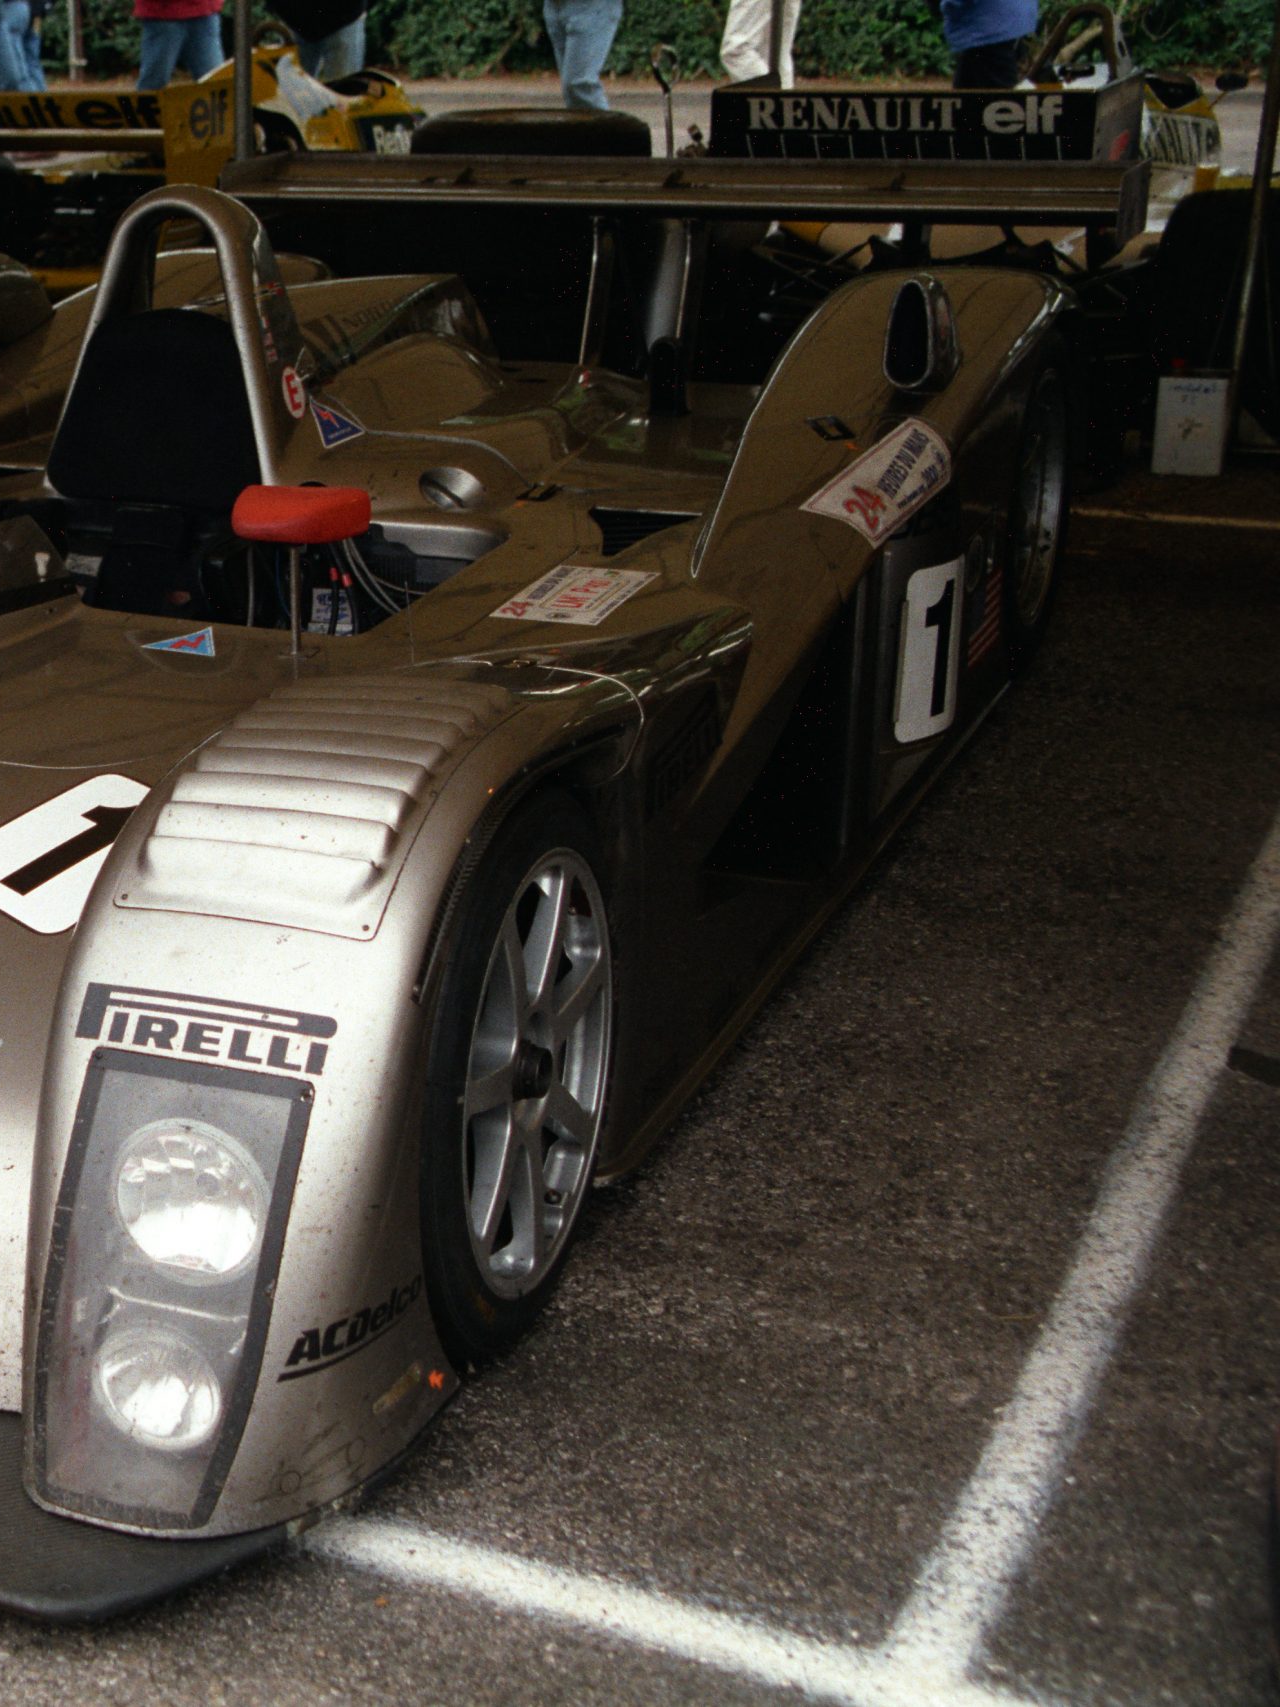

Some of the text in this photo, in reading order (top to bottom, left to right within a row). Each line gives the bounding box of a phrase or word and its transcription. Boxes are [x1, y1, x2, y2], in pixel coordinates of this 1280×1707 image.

[75, 95, 162, 130] elf
[189, 87, 229, 138] elf
[746, 94, 1064, 135] RENAULT elf
[285, 373, 302, 411] E
[842, 485, 886, 531] 24
[925, 578, 956, 718] 1
[75, 982, 338, 1076] PIRELLI
[285, 1274, 422, 1367] ACDelco
